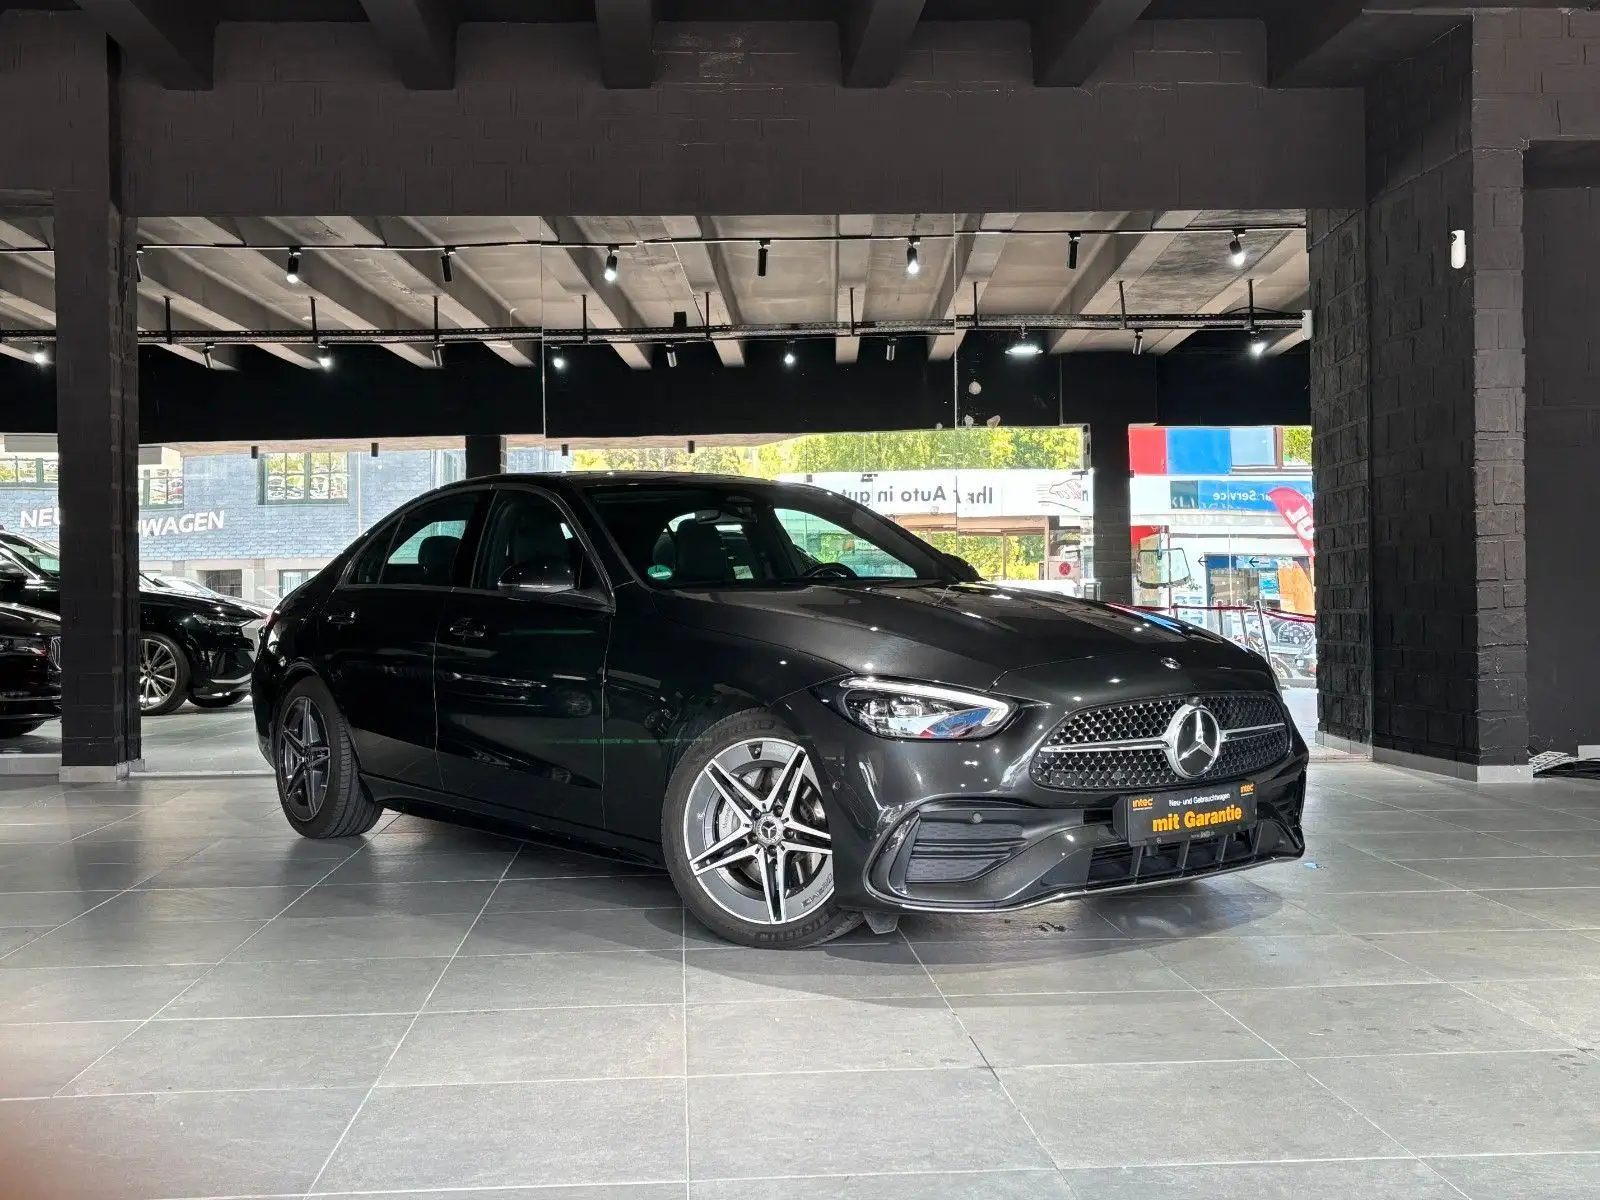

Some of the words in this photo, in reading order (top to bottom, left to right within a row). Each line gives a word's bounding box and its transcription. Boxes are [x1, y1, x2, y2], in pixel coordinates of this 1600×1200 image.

[138, 509, 225, 538] WAGEN
[1183, 796, 1193, 805] und
[1152, 813, 1180, 832] mit
[1184, 804, 1243, 829] Garantie
